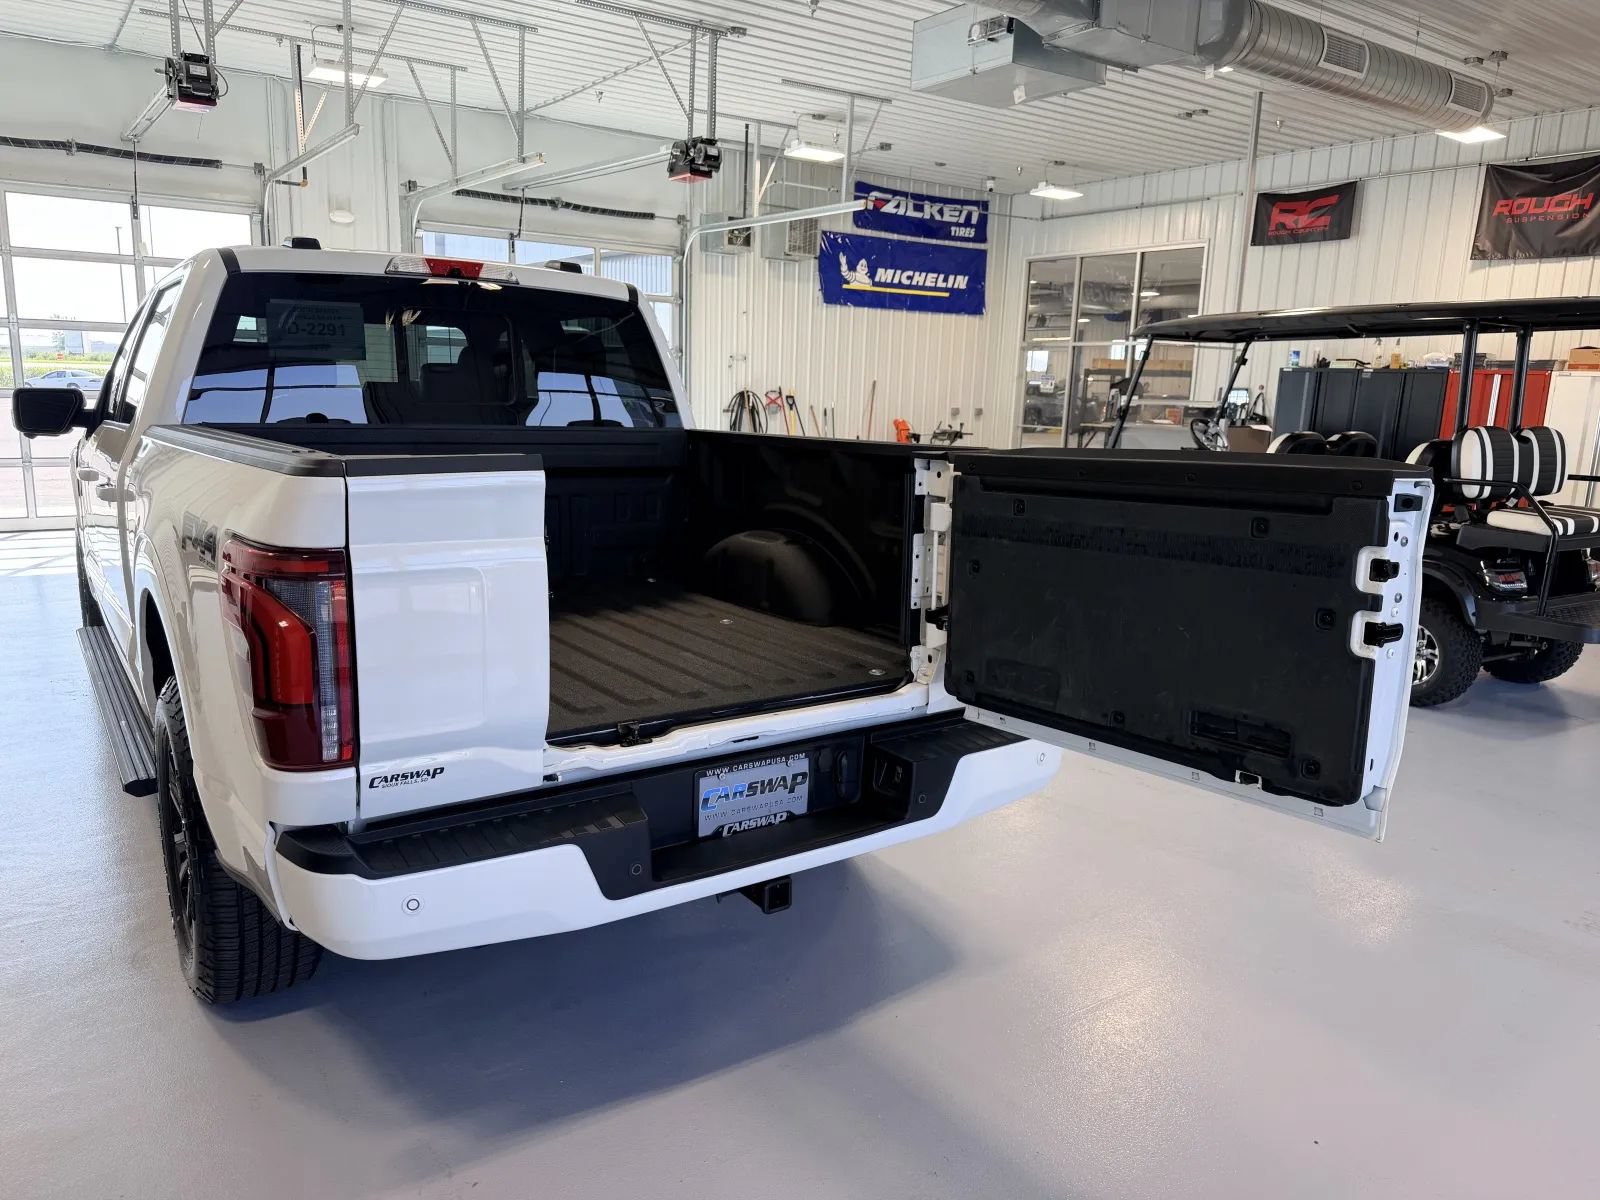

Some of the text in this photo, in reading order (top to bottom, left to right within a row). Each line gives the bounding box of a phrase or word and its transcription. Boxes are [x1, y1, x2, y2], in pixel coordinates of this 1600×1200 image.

[867, 191, 980, 225] FALKEN
[1268, 194, 1340, 231] RC
[1492, 193, 1594, 216] ROUGH
[1505, 212, 1590, 224] SUSPENSION
[950, 226, 975, 238] TIRES
[874, 268, 969, 290] MICHELIN
[706, 752, 807, 777] WWW.CARSWAPUSA.COM
[368, 767, 445, 789] CARSWAP
[701, 771, 809, 812] CARSWAP
[722, 811, 789, 838] CARSWAP
